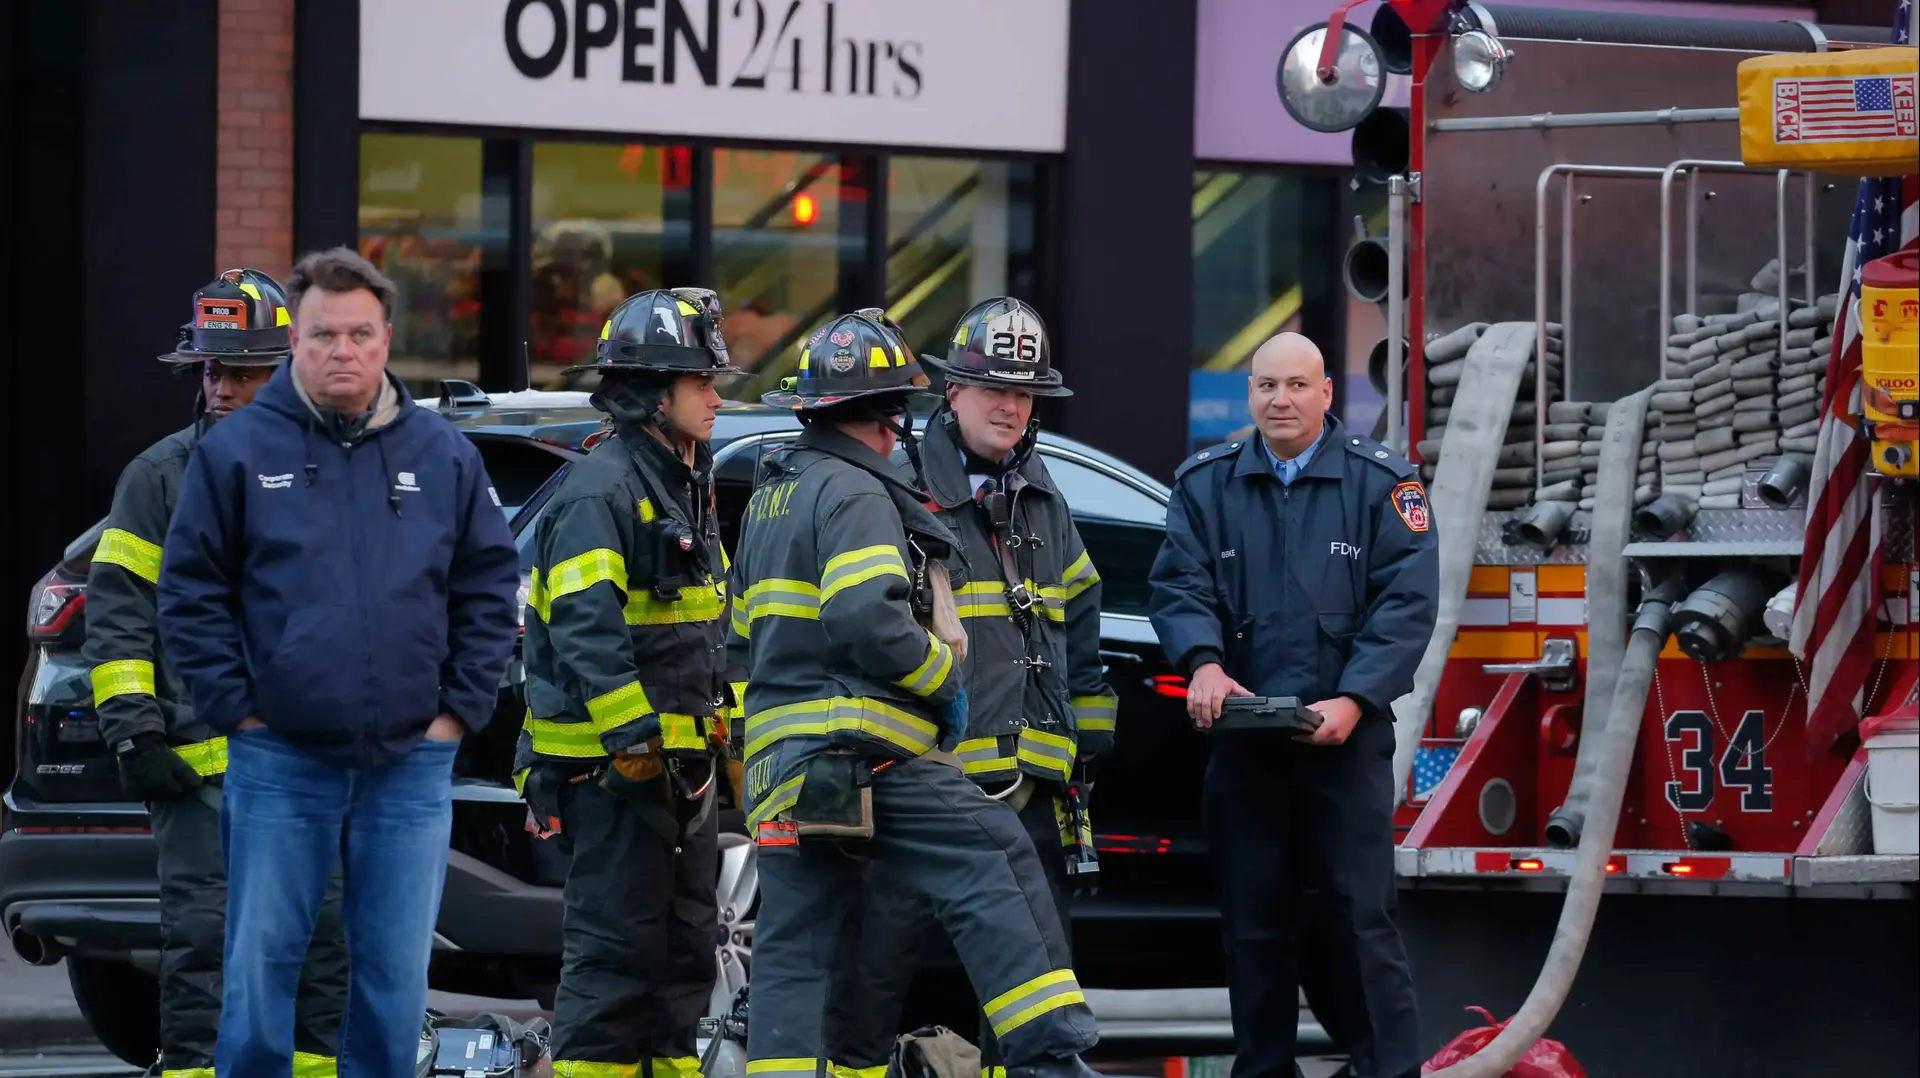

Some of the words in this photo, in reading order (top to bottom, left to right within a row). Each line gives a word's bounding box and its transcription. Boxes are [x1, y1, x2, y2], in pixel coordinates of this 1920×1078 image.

[504, 0, 719, 87] OPEN
[729, 0, 812, 92] 24
[821, 2, 925, 99] hrs
[1777, 84, 1800, 140] BACK
[1893, 80, 1915, 135] KEEP
[993, 332, 1037, 361] 26
[1876, 378, 1916, 388] IGLOO
[748, 481, 799, 521] FD.N.Y.
[36, 764, 85, 774] EDGE
[1665, 710, 1773, 812] 34
